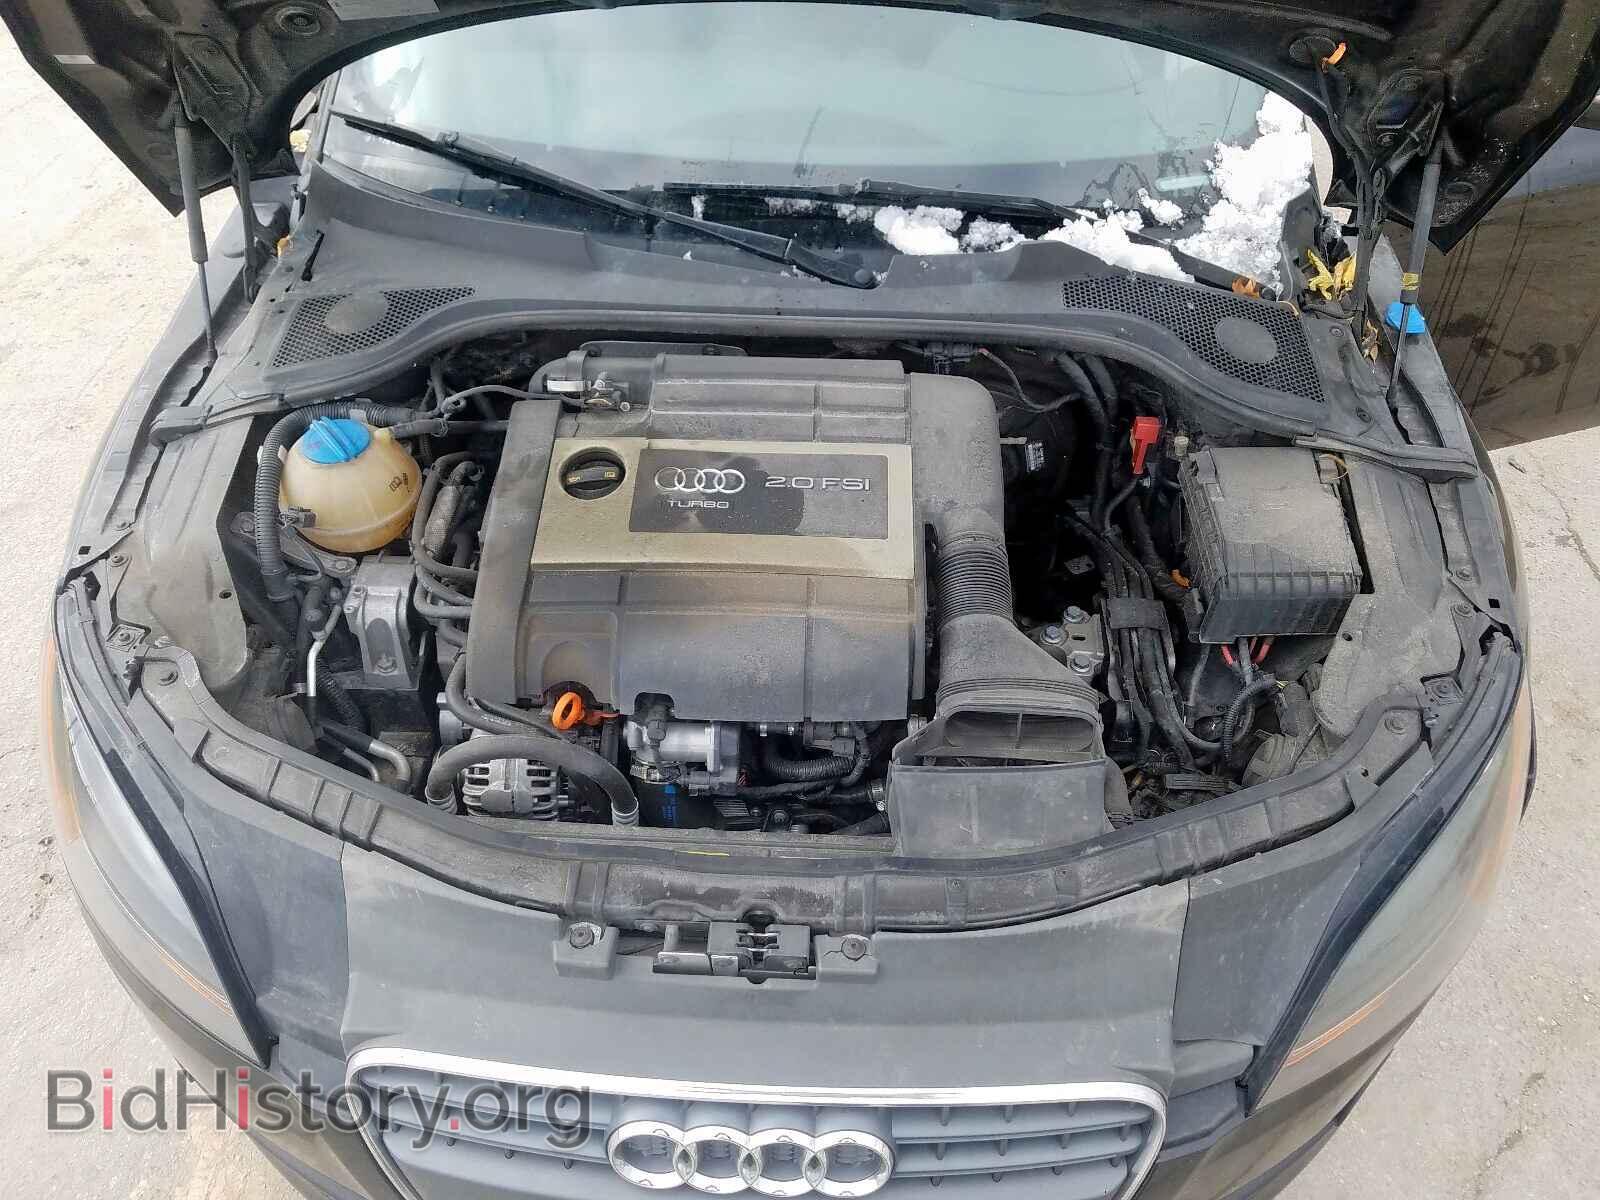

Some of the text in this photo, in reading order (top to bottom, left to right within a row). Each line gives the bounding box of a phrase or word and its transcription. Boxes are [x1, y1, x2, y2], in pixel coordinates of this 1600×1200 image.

[765, 476, 871, 491] 2.0 FSI
[667, 500, 729, 509] TURBO
